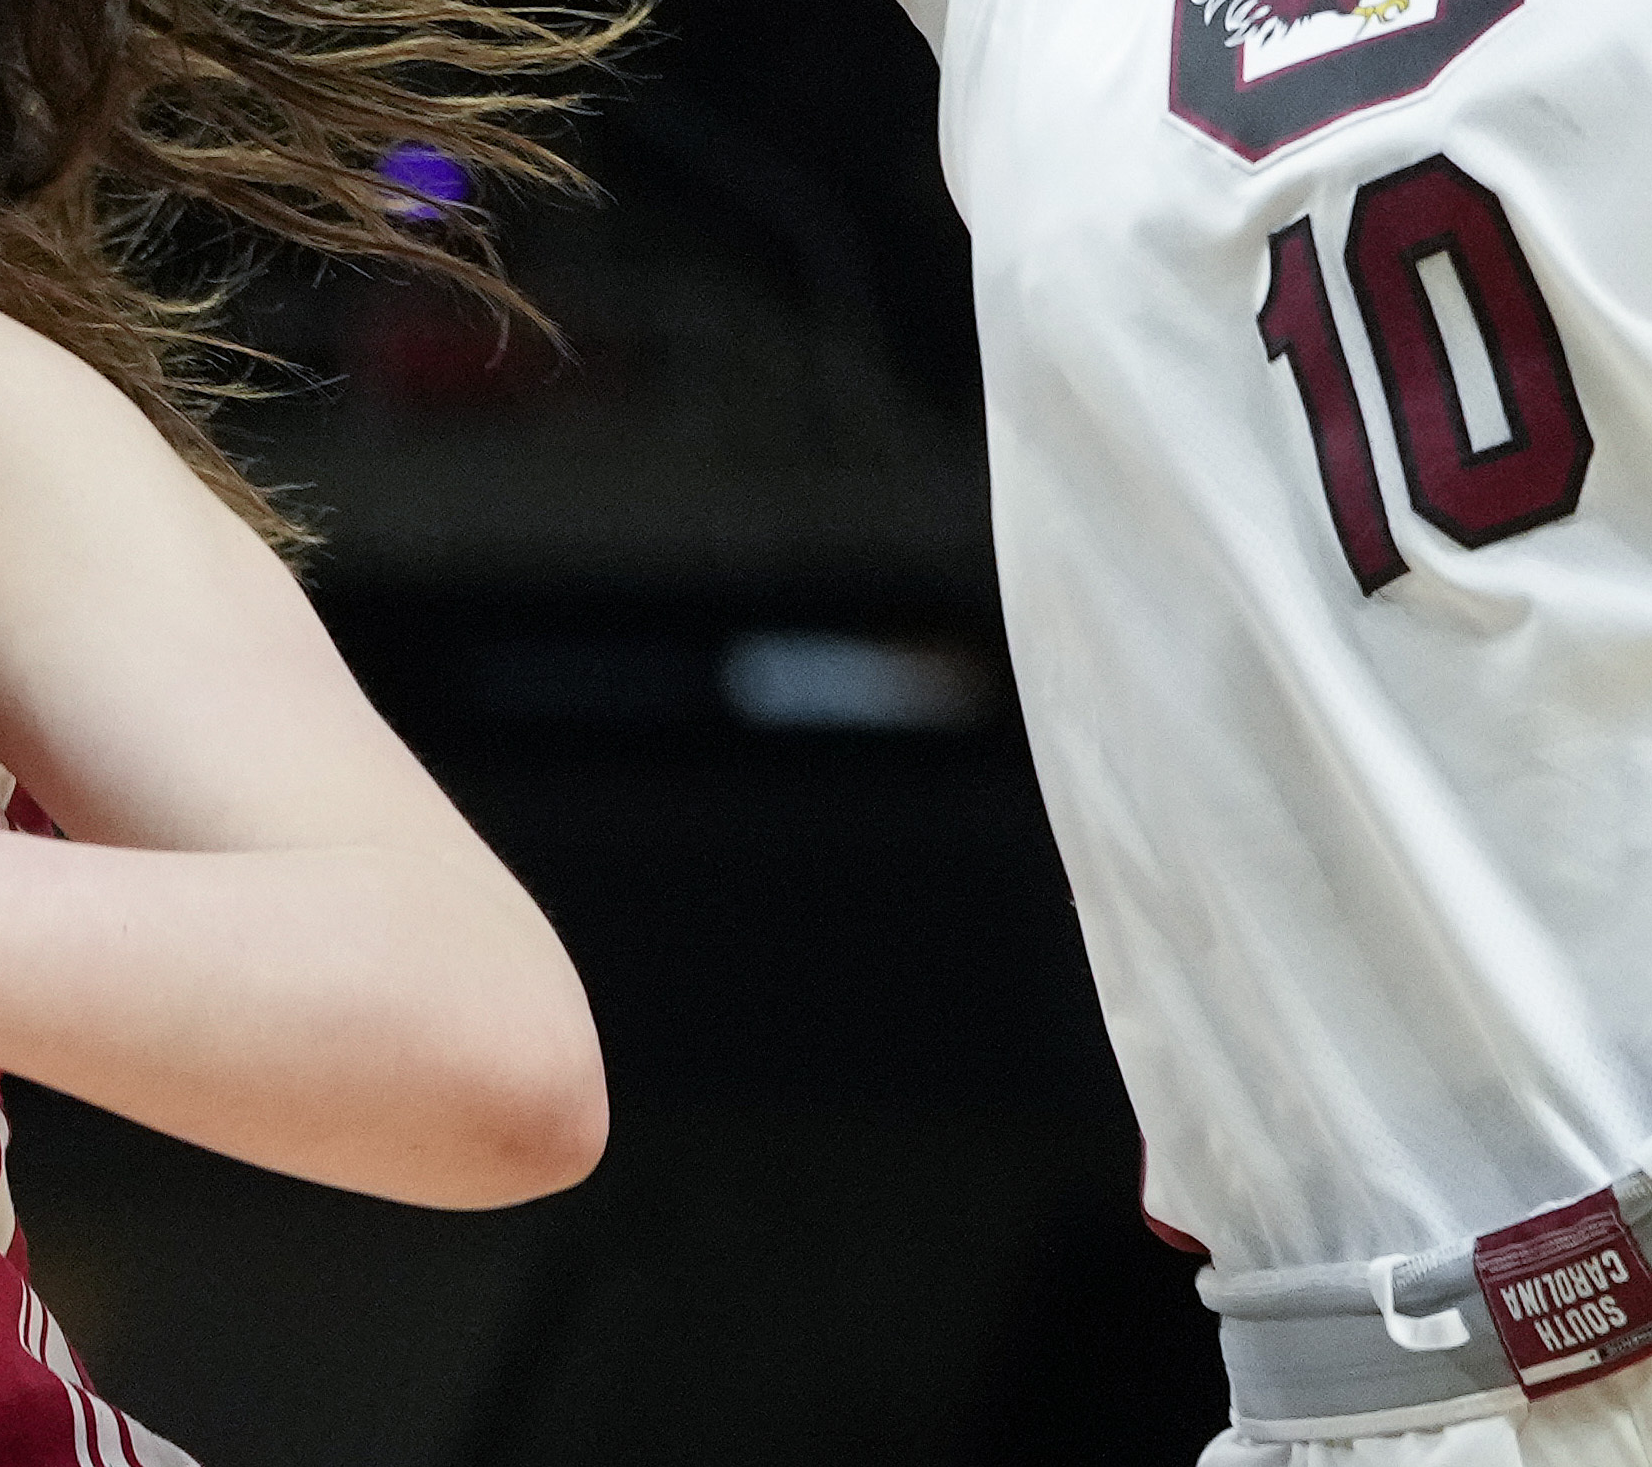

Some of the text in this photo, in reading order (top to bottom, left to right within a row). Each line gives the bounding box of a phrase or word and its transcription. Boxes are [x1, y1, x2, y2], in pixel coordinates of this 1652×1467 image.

[1256, 152, 1594, 598] 10
[1500, 1249, 1630, 1321] CAROLINA
[1534, 1295, 1628, 1351] SOUTH
